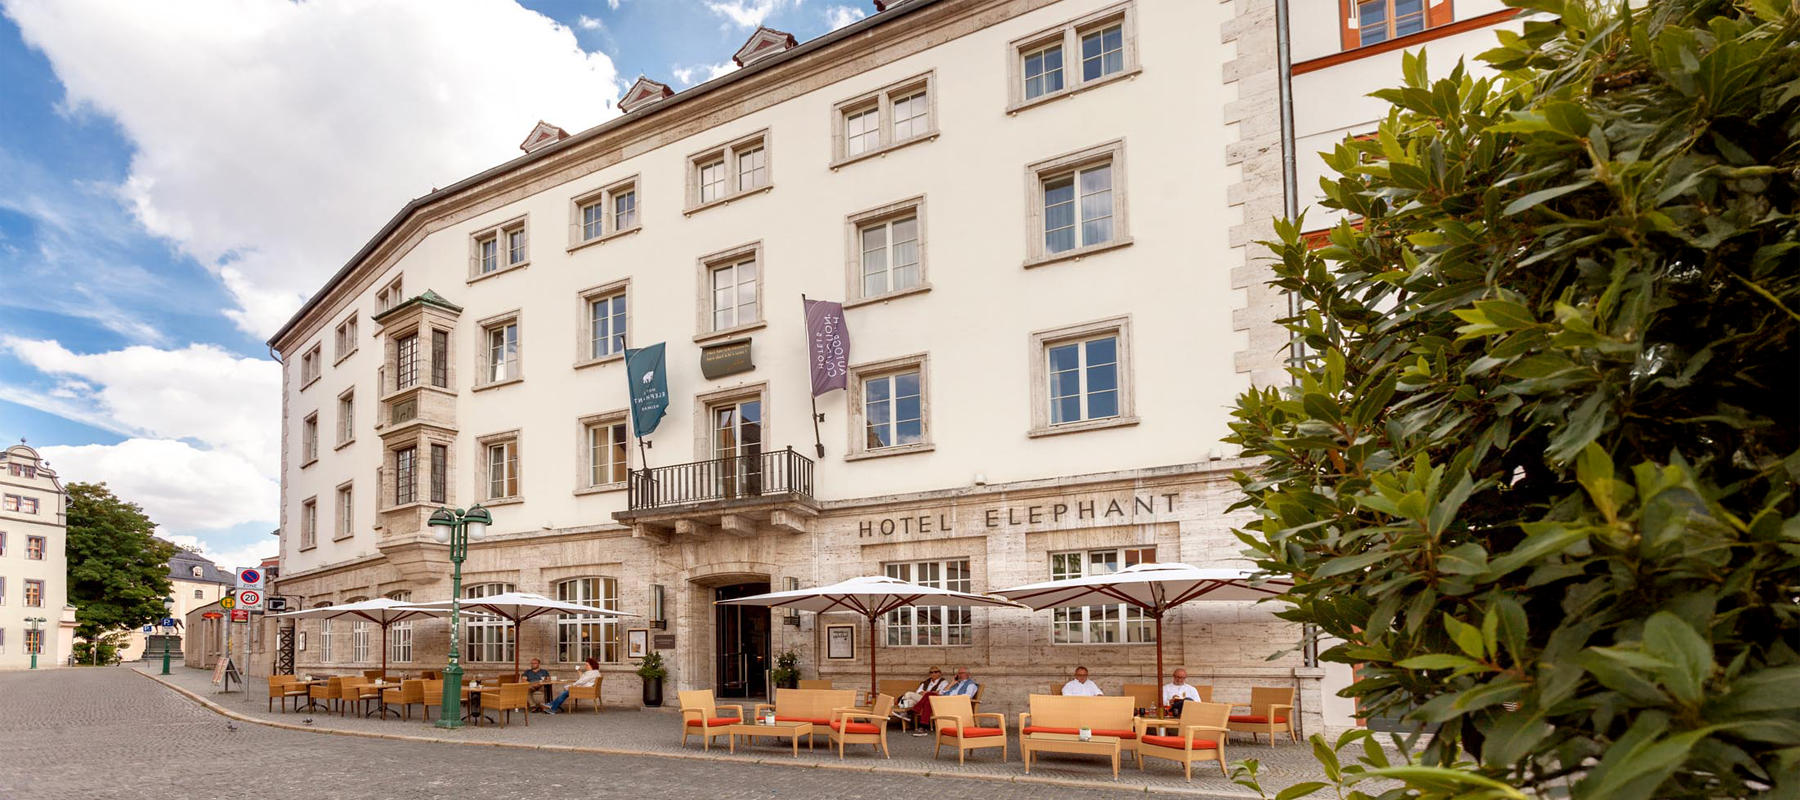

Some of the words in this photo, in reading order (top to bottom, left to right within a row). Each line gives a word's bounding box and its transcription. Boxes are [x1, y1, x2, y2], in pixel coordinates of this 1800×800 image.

[859, 514, 952, 538] HOTEL
[985, 493, 1180, 528] ELEPHANT
[244, 594, 256, 602] 20
